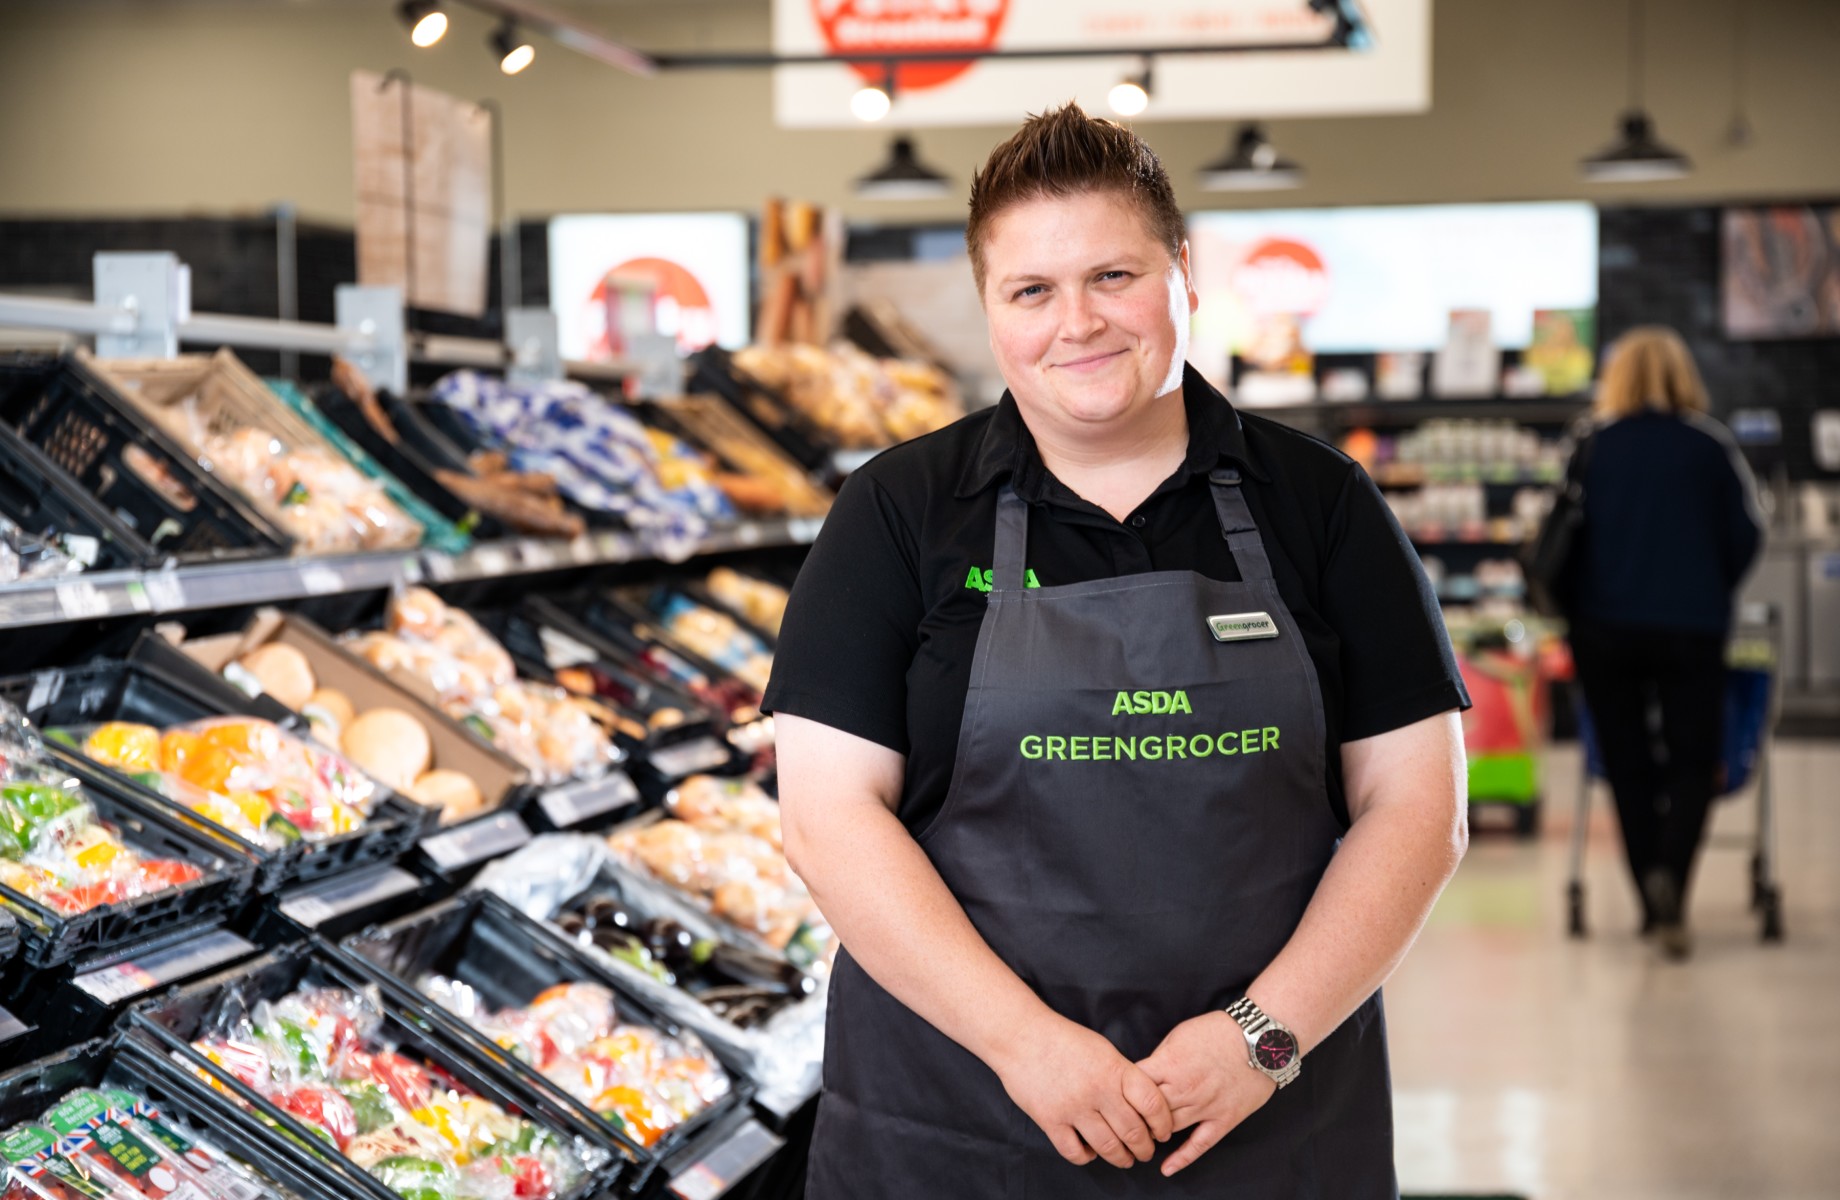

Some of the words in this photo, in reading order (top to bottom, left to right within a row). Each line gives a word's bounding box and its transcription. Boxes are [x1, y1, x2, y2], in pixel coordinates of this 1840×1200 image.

[965, 566, 1041, 592] ASA
[1216, 620, 1270, 632] Greengrocer
[1112, 690, 1192, 715] ASDA
[1020, 726, 1280, 761] GREENGROCER
